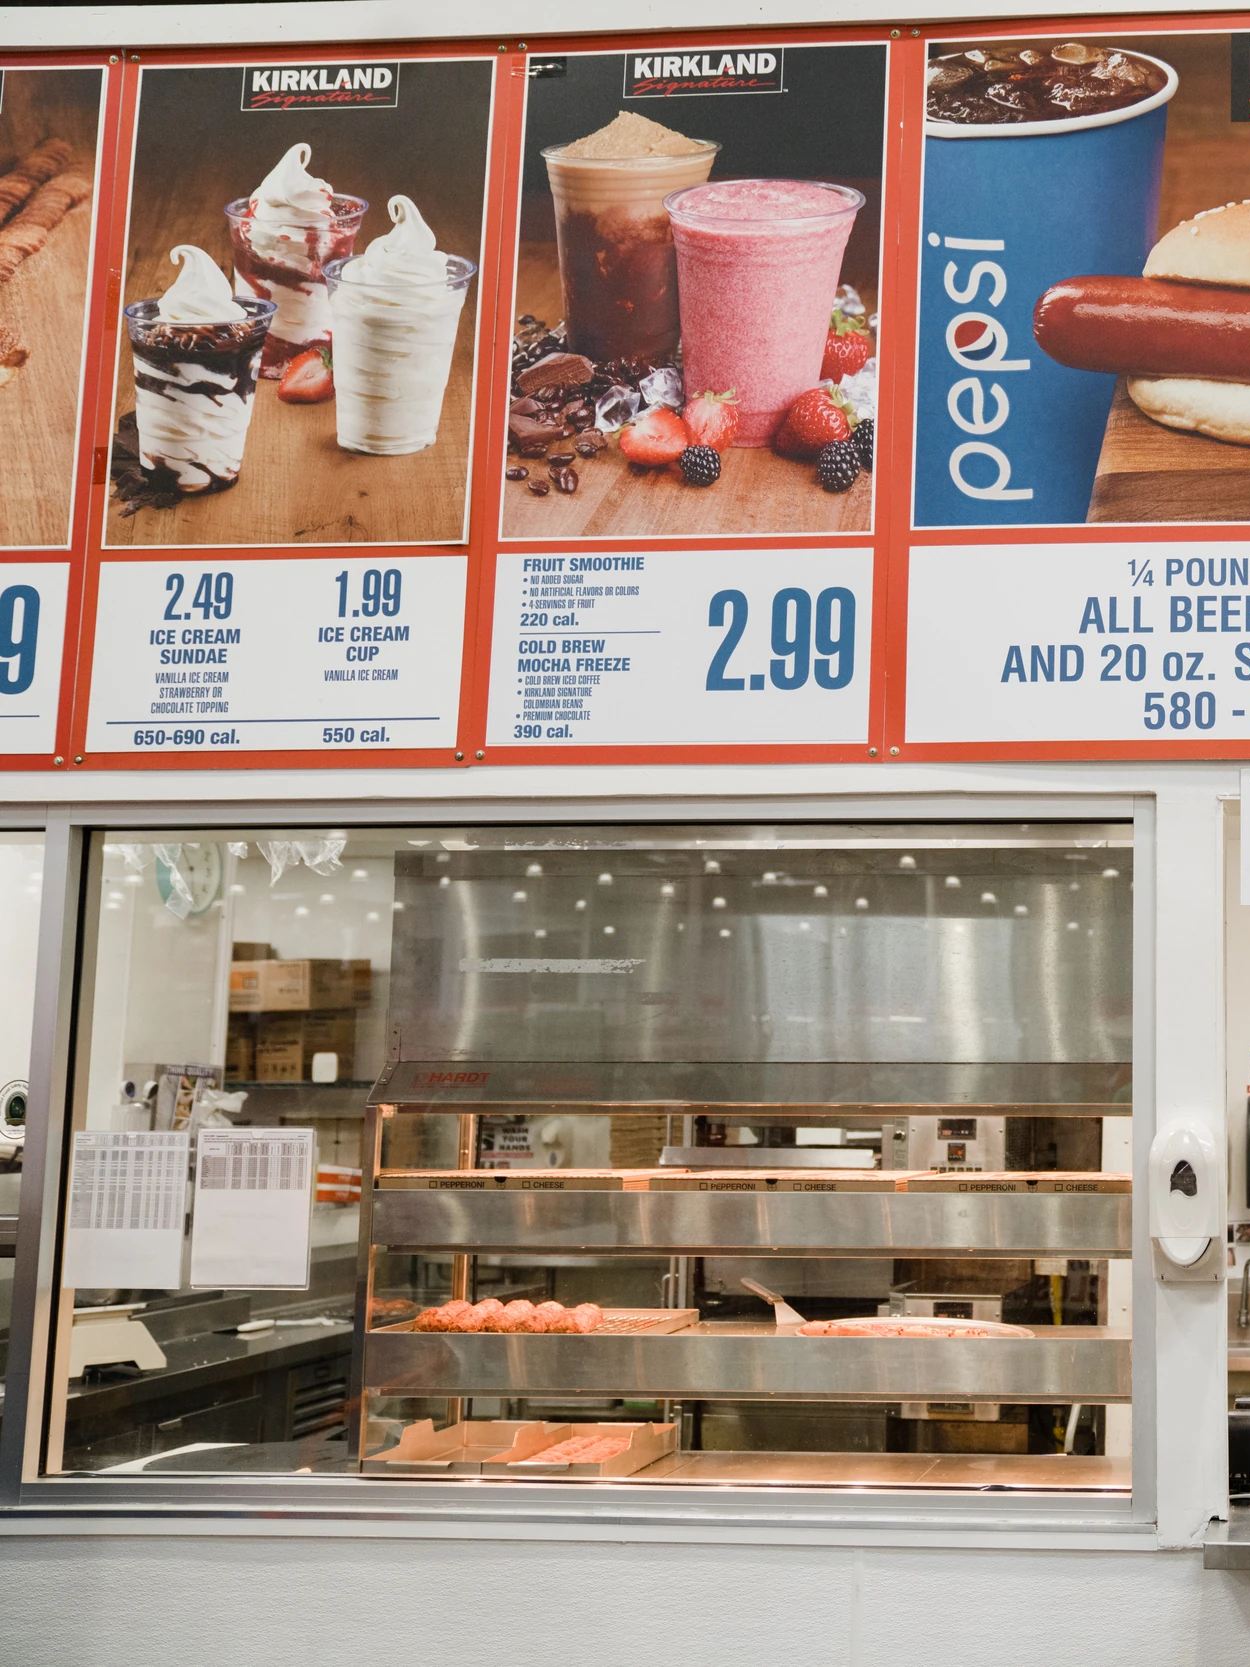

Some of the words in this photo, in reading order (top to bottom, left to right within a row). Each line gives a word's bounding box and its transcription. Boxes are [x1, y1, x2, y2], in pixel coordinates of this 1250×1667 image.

[634, 53, 777, 78] KIRKLAND
[252, 67, 392, 92] KIRKLAND
[633, 77, 776, 97] Signature
[250, 90, 391, 111] Signature
[927, 231, 1033, 501] pepsi
[523, 558, 565, 572] FRUIT
[569, 557, 644, 571] SMOOTHIE
[530, 575, 539, 585] NO
[541, 575, 561, 585] ADDED
[563, 574, 584, 584] SUGAR
[164, 572, 234, 621] 2.49
[335, 568, 402, 619] 1.99
[529, 587, 539, 597] NO
[540, 587, 574, 597] ARTIFICIAL
[576, 586, 603, 596] FLAVORS
[605, 586, 613, 596] OR
[615, 586, 639, 596] COLORS
[568, 599, 576, 609] OF
[577, 599, 595, 608] FRUIT
[520, 613, 548, 627] 220
[552, 612, 579, 626] cal.
[1079, 596, 1154, 634] ALL
[149, 629, 176, 646] ICE
[181, 628, 241, 646] CREAM
[318, 627, 344, 643] ICE
[349, 626, 410, 643] CREAM
[705, 586, 856, 692] 2.99
[345, 645, 380, 663] CUP
[518, 640, 557, 654] COLD
[562, 639, 605, 654] BREW
[160, 648, 227, 665] SUNDAE
[1000, 644, 1085, 683] AND
[1100, 643, 1147, 682] 20
[1163, 652, 1216, 682] oz.
[517, 658, 571, 672] MOCHA
[576, 658, 631, 672] FREEZE
[155, 671, 187, 684] VANILLA
[189, 671, 200, 684] ICE
[202, 671, 229, 683] CREAM
[324, 669, 355, 682] VANILLA
[357, 669, 369, 682] ICE
[371, 669, 398, 681] CREAM
[525, 675, 541, 685] COLD
[542, 675, 561, 685] BREW
[562, 675, 576, 685] ICED
[578, 675, 600, 685] COFFEE
[159, 686, 209, 699] STRAWBERRY
[212, 686, 223, 699] OR
[524, 687, 555, 697] KIRKLAND
[557, 687, 592, 697] SIGNATURE
[150, 701, 195, 714] CHOCOLATE
[197, 700, 228, 714] TOPPING
[523, 699, 560, 709] COLOMBIAN
[562, 699, 583, 709] BEANS
[1143, 691, 1217, 730] 580
[523, 711, 553, 721] PREMIUM
[554, 710, 591, 721] CHOCOLATE
[134, 729, 205, 746] 650-690
[210, 728, 240, 745] cal.
[323, 727, 354, 744] 550
[360, 726, 390, 743] cal.
[513, 725, 542, 739] 390
[546, 724, 573, 738] cal.
[429, 1072, 491, 1083] HARDT
[440, 1181, 485, 1189] PEPPERONI
[533, 1181, 565, 1189] CHEESE
[710, 1182, 756, 1190] PEPPERONI
[804, 1183, 836, 1191] CHEESE
[970, 1184, 1016, 1192] PEPPERONI
[1065, 1183, 1099, 1191] CHEESE
